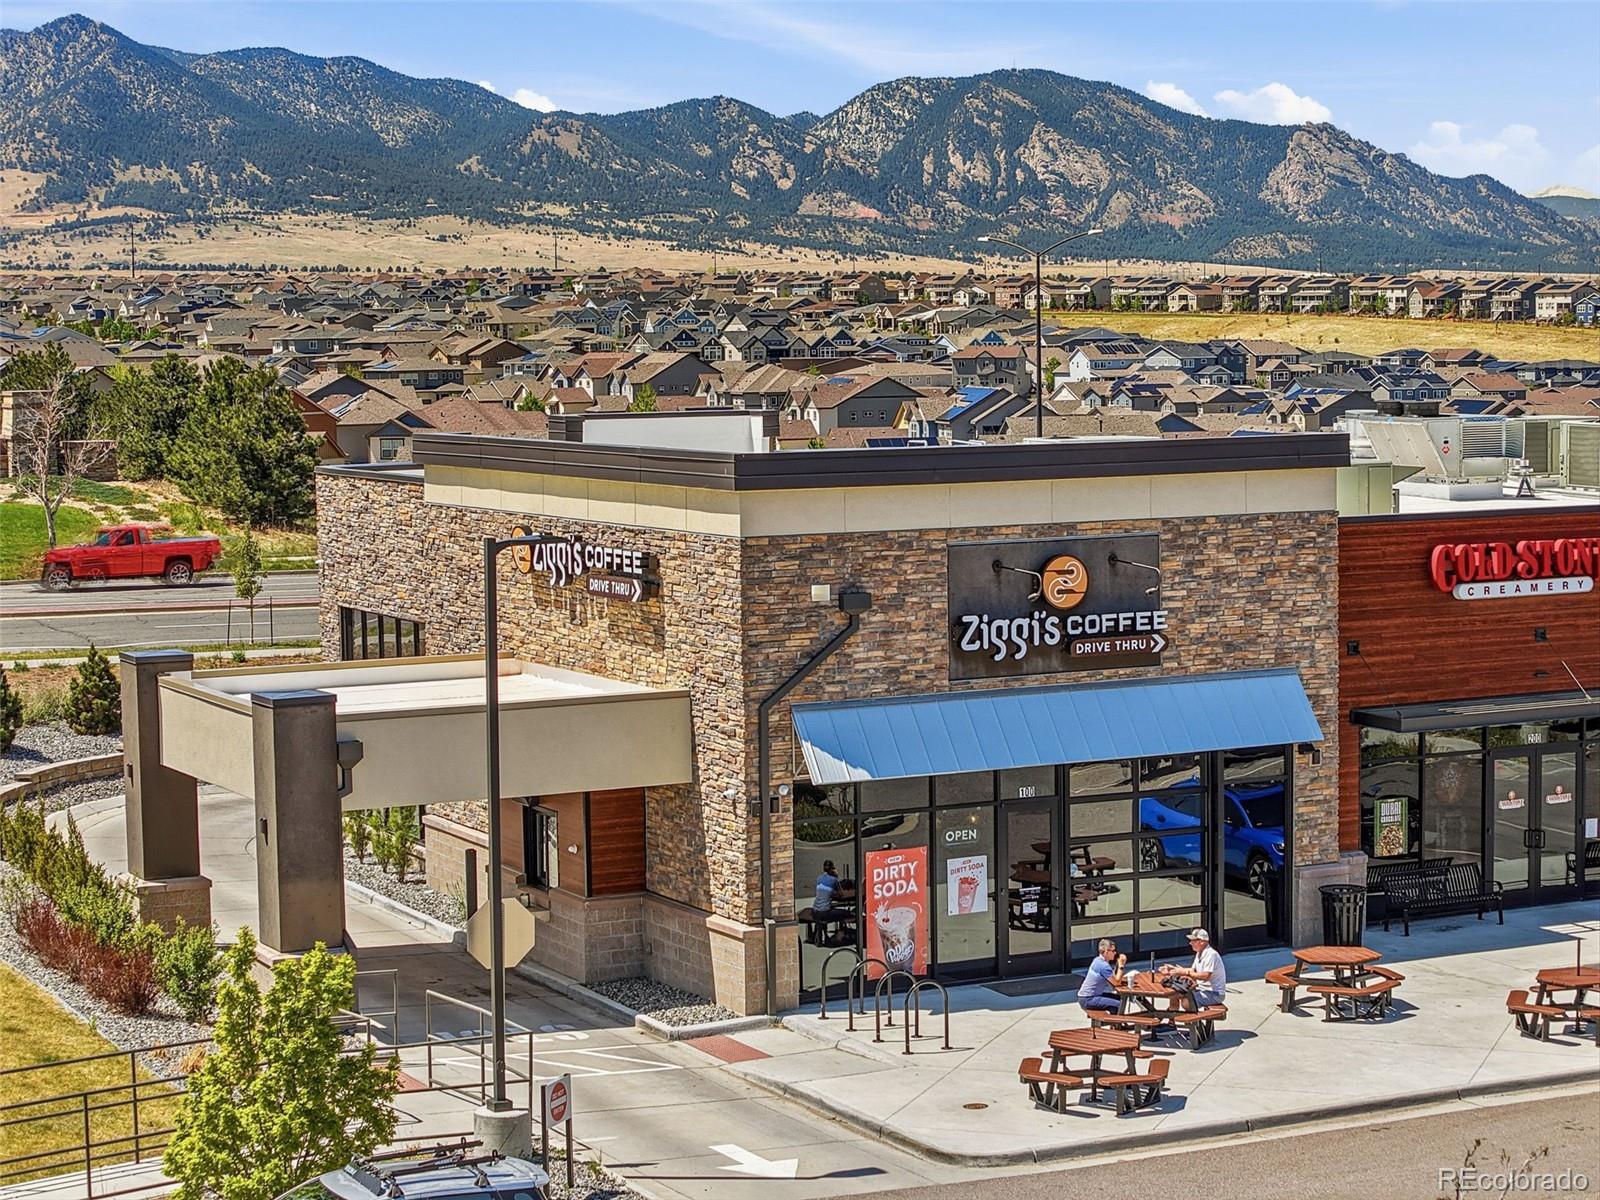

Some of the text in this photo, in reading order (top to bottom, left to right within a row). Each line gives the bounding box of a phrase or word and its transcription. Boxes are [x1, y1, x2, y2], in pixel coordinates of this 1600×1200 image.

[585, 544, 643, 575] COFFEE
[1431, 544, 1513, 592] COLD
[589, 578, 630, 596] DRIVE THRU
[1467, 580, 1584, 597] CREAMERY
[960, 610, 1168, 662] Ziggi's COFFEE
[1075, 639, 1147, 654] DRIVE THRU
[1019, 786, 1036, 798] 100
[945, 828, 977, 842] OPEN
[873, 860, 919, 882] DIRTY
[950, 865, 968, 876] DIRTY
[968, 861, 985, 871] SODA
[873, 877, 920, 900] SODA
